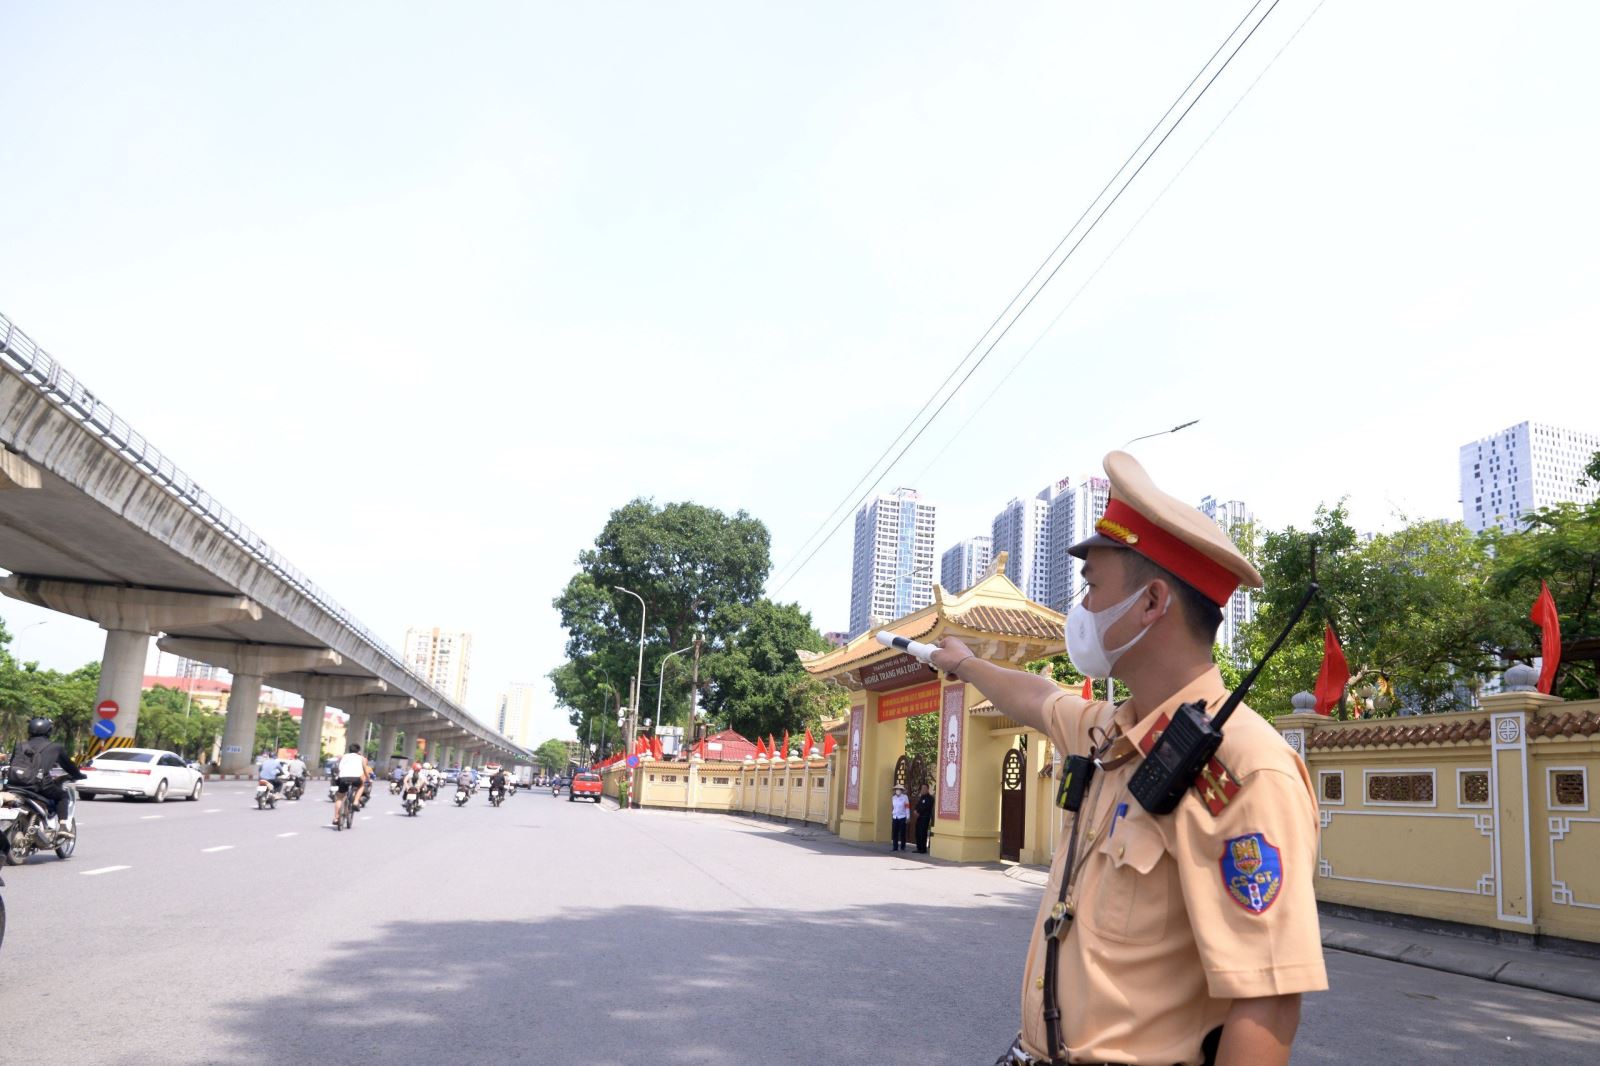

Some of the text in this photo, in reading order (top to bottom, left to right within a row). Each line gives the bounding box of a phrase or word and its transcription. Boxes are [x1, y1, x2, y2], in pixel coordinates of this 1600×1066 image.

[896, 665, 908, 676] MAI
[1231, 871, 1271, 887] CS GT
